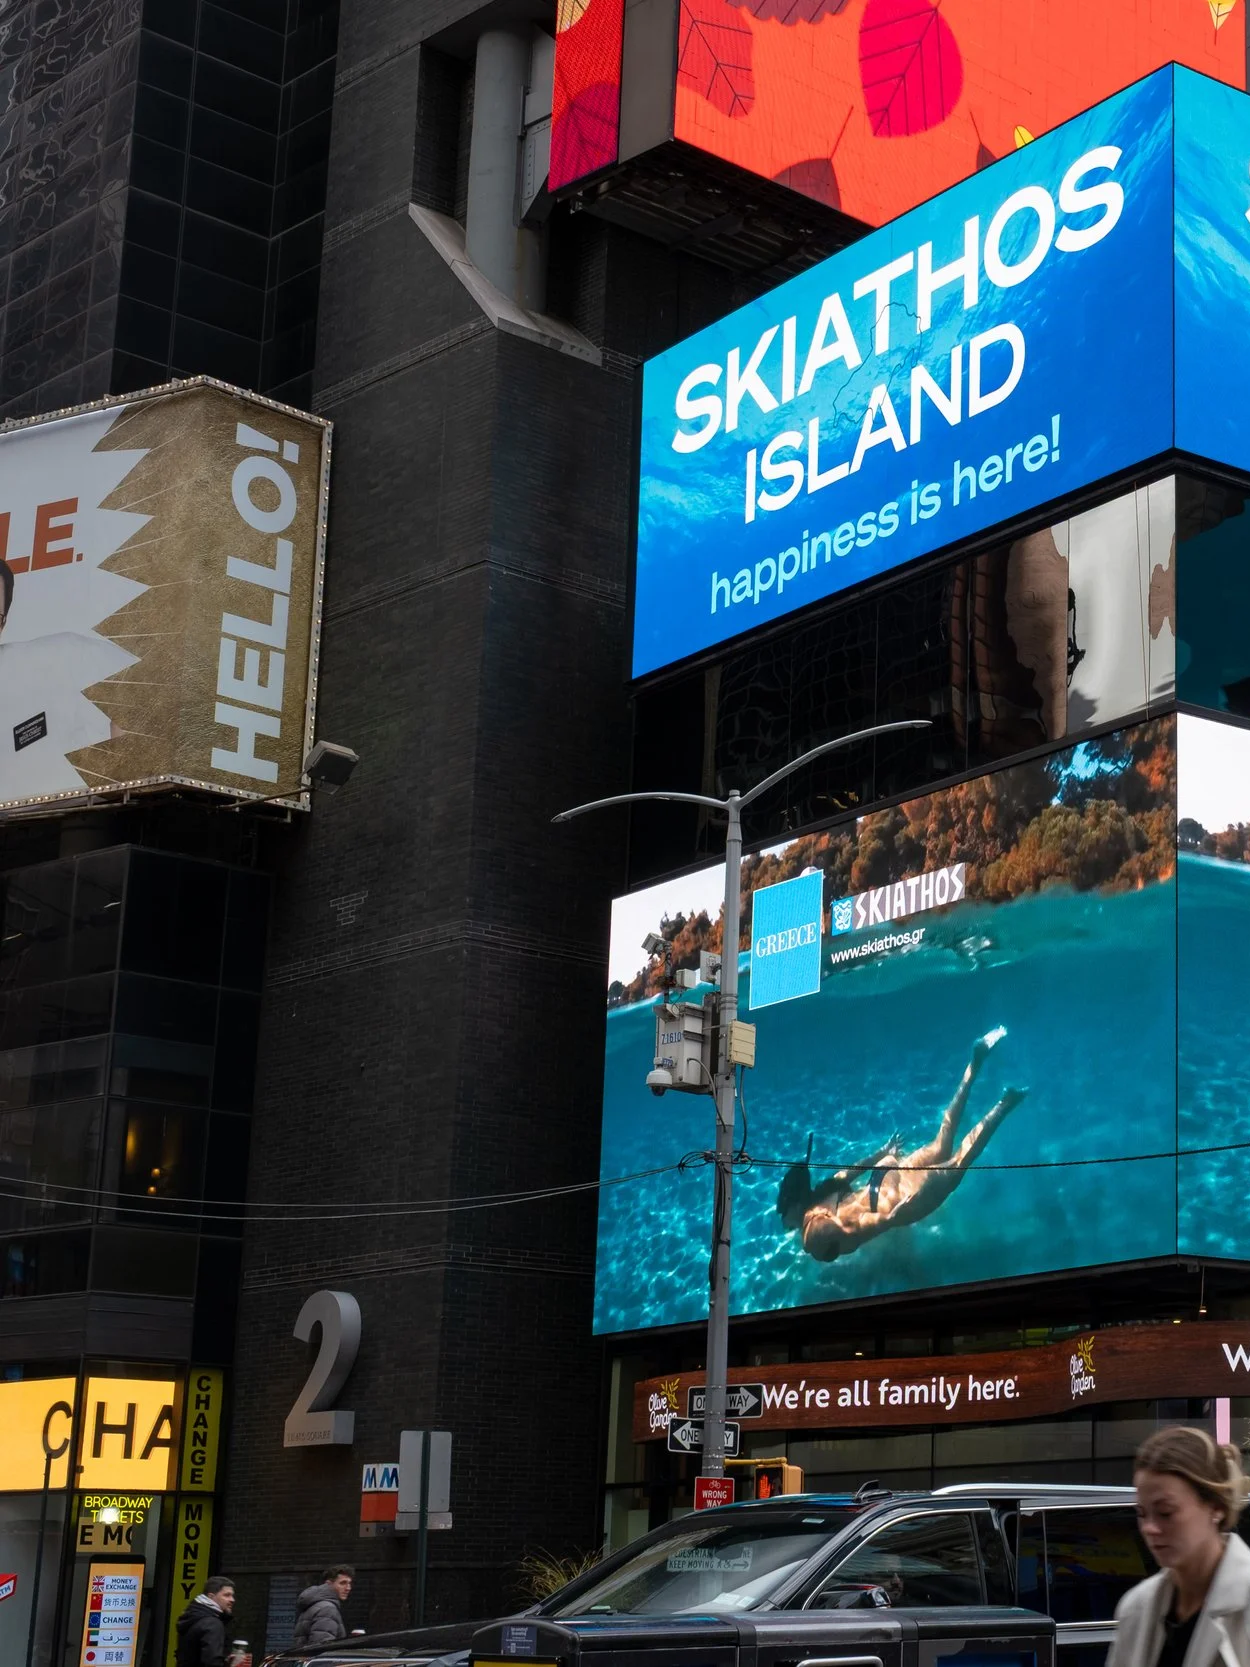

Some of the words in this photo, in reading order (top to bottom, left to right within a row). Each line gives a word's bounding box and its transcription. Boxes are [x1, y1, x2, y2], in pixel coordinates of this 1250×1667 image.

[671, 144, 1127, 454] SKIATHOS
[743, 323, 1027, 525] ISLAND
[710, 501, 899, 614] happiness
[909, 480, 941, 526] is
[952, 413, 1062, 506] here!
[210, 422, 301, 784] HELLO!
[855, 862, 964, 930] SKIATHOS
[755, 922, 817, 958] GREECE
[830, 926, 926, 965] www.skiathos.gr
[283, 1289, 362, 1448] 2
[1069, 1354, 1084, 1376] Olive
[728, 1393, 750, 1408] WAY
[762, 1380, 830, 1409] We're
[837, 1380, 870, 1407] all
[878, 1375, 961, 1410] family
[1071, 1371, 1096, 1400] Garden
[648, 1392, 668, 1412] Olive
[189, 1375, 212, 1485] CHANGE
[680, 1428, 700, 1442] ONE
[84, 1496, 153, 1508] BROADWAY
[702, 1491, 727, 1499] WRONG
[706, 1499, 722, 1507] WAY
[91, 1510, 144, 1524] TKETS
[180, 1503, 203, 1600] MONEY
[669, 1560, 686, 1568] KEEP
[687, 1560, 714, 1568] MOVING
[102, 1616, 134, 1624] CHANGE
